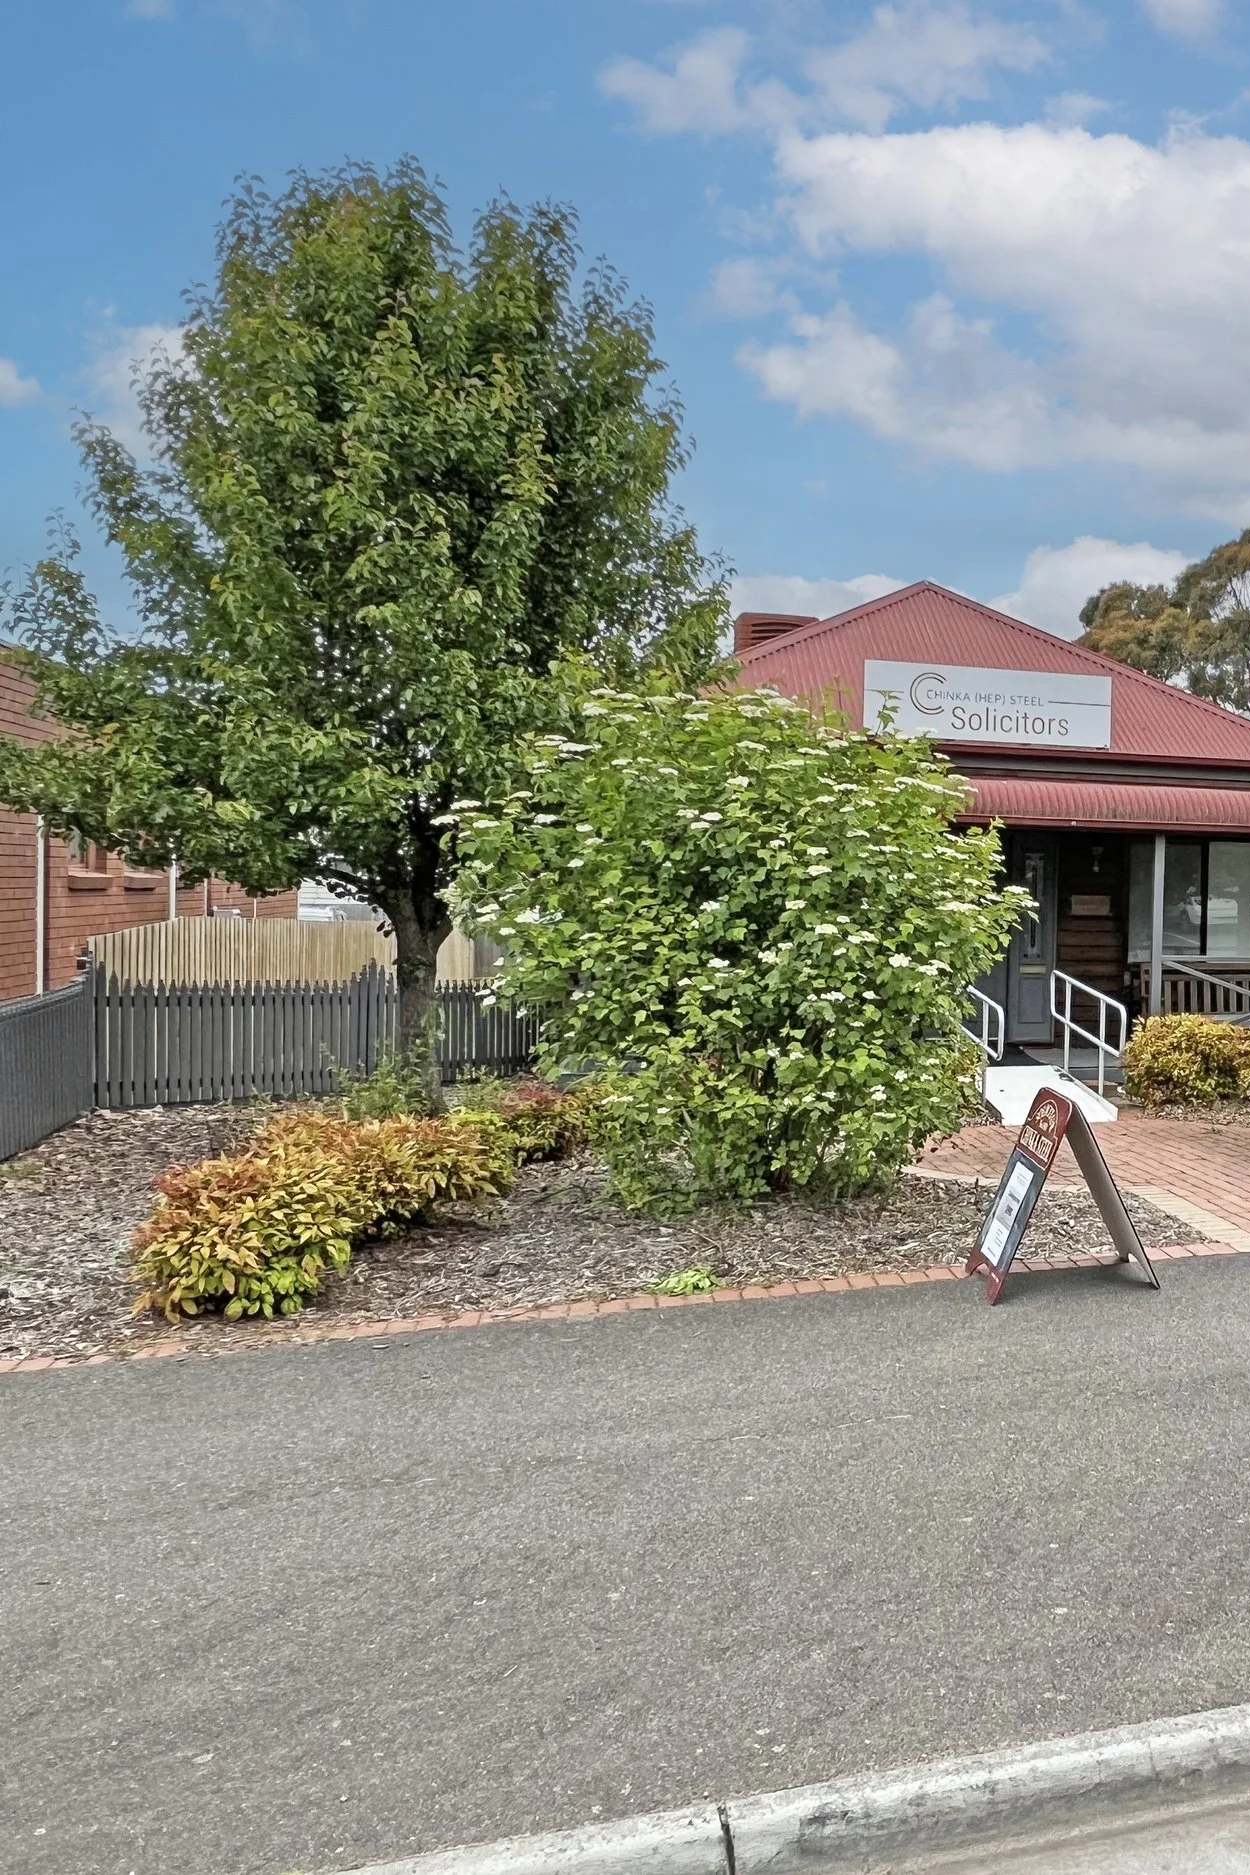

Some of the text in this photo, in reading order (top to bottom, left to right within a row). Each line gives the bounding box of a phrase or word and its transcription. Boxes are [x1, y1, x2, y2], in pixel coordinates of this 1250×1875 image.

[926, 689, 1044, 707] CHINKA (HEP) STEEL
[951, 706, 1069, 736] Solicitors
